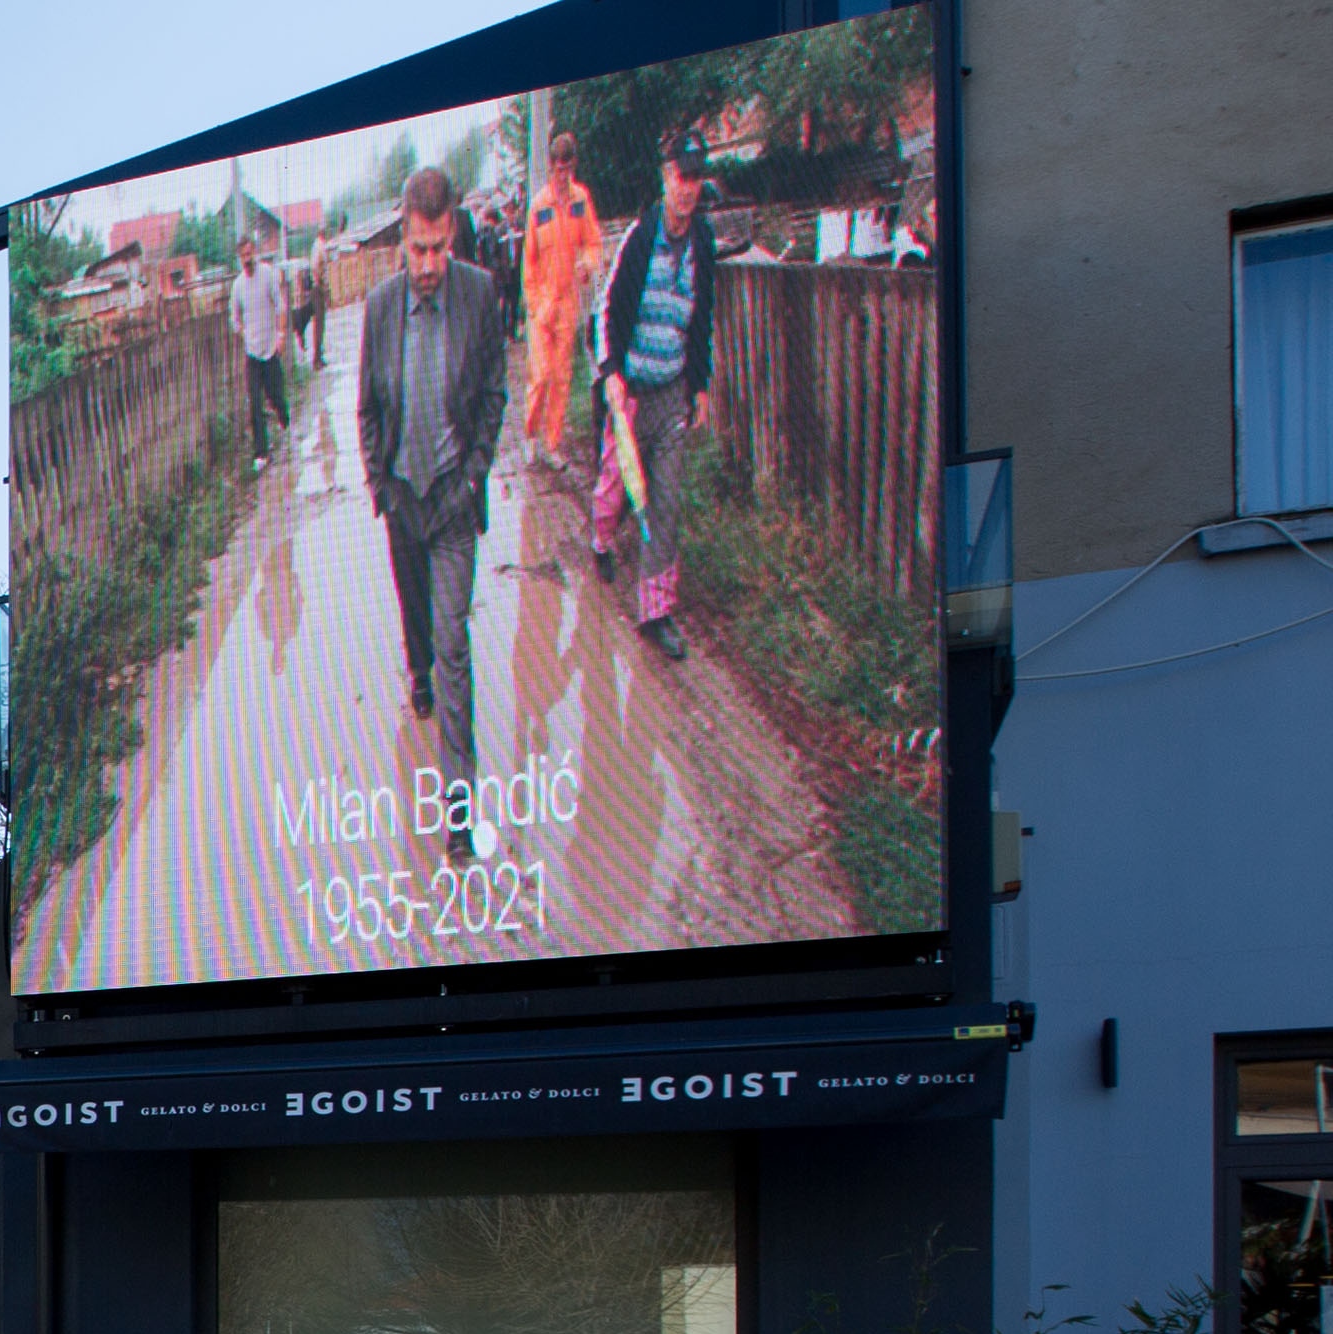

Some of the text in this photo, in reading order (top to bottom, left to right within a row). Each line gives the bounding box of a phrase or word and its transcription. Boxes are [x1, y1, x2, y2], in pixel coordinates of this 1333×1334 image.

[274, 750, 579, 848] Milan Bandić
[297, 861, 547, 944] 1955-2021
[140, 1105, 197, 1117] GELATO
[202, 1101, 215, 1114] &
[220, 1102, 266, 1113] DOLCI
[459, 1090, 522, 1102] GELATO
[527, 1087, 542, 1100] &
[548, 1087, 600, 1099] DOLCI
[817, 1075, 888, 1088] GELATO
[894, 1072, 912, 1085] &
[918, 1072, 975, 1085] DOLCI
